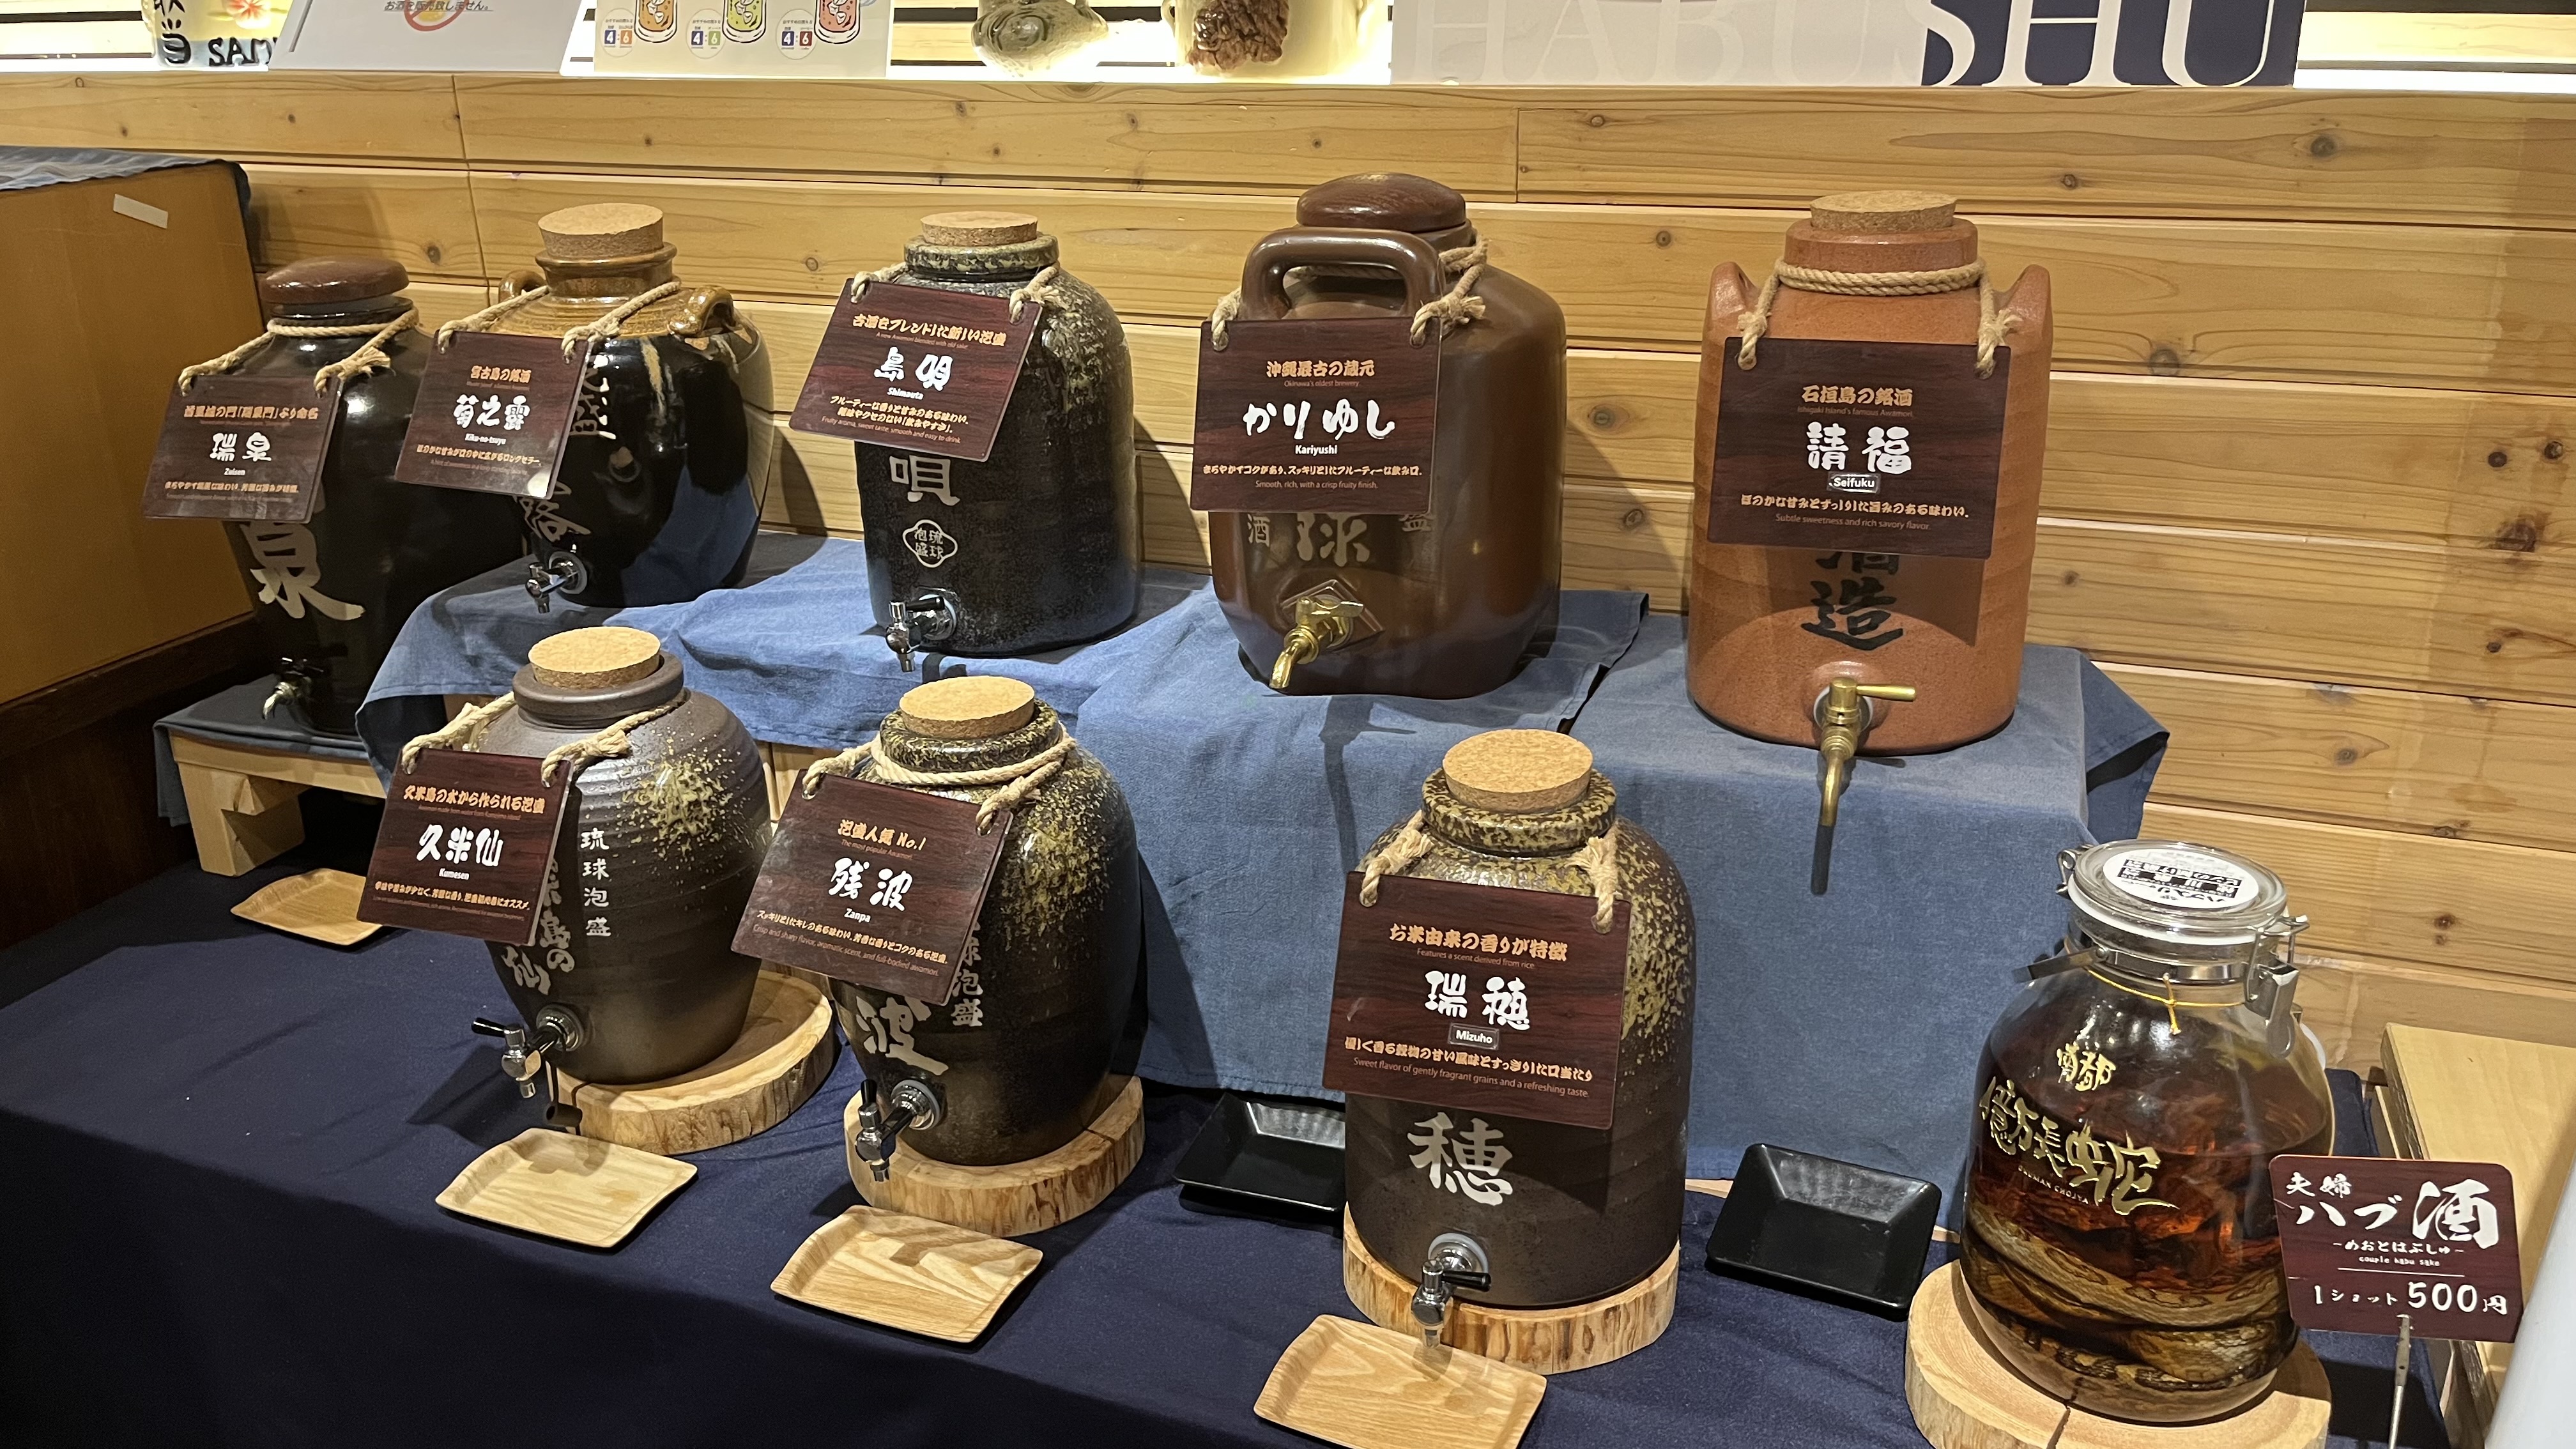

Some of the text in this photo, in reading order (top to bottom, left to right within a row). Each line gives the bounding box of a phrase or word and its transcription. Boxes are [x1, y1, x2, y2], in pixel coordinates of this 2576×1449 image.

[208, 37, 279, 66] SAM
[852, 313, 1008, 346] 古酒をブレンドした新しい泡盛
[471, 365, 532, 383] 宮古島の銘酒
[1266, 360, 1375, 378] 沖縄最古の蔵元
[887, 387, 924, 401] Shimauta
[1802, 385, 1913, 406] 石垣島の銘酒
[453, 394, 530, 431] 菊之露
[1243, 398, 1395, 441] かりゆし
[210, 431, 272, 461] 瑞泉
[890, 427, 912, 436] smooth
[924, 433, 938, 441] easy
[1805, 421, 1912, 475] 請福
[1295, 445, 1337, 457] Kariyushi
[889, 454, 961, 507] 唄
[1255, 480, 1282, 488] Smooth,
[1338, 481, 1356, 489] fruity
[1833, 477, 1875, 489] Seifuku
[1775, 513, 1801, 523] Subtle
[1802, 516, 1844, 525] sweetness
[1844, 518, 1860, 526] and
[1861, 518, 1877, 527] rich
[1878, 521, 1905, 530] savory
[403, 785, 546, 814] 久米島の水から作られる泡盛
[416, 824, 503, 867] 久米仙
[837, 819, 926, 851] 泡盛人気 No.1
[580, 827, 611, 937] 琉球泡盛
[829, 857, 913, 912] 残波
[844, 907, 871, 923] Zanpa
[768, 928, 781, 937] and
[780, 931, 798, 942] sharp
[1389, 923, 1568, 962] お米由来の香りが特徴
[1416, 947, 1447, 959] Features
[1453, 953, 1473, 962] scent
[1473, 954, 1501, 965] derived
[1501, 958, 1520, 967] from
[1424, 970, 1529, 1031] 瑞穂
[1455, 1029, 1492, 1044] Mizuho
[1353, 1057, 1377, 1069] Sweet
[1378, 1060, 1401, 1071] flavor
[1402, 1063, 1412, 1073] of
[1412, 1064, 1438, 1079] gently
[1439, 1069, 1472, 1084] fragrant
[1473, 1074, 1498, 1087] grains
[1499, 1077, 1516, 1087] and
[1522, 1080, 1566, 1097] refreshing
[1407, 1112, 1513, 1206] 穂
[2285, 1171, 2352, 1199] 夫婦
[2296, 1178, 2499, 1250] ハブ酒
[2359, 1255, 2389, 1264] couple
[2419, 1258, 2441, 1267] sake
[2407, 1281, 2508, 1315] 500円
